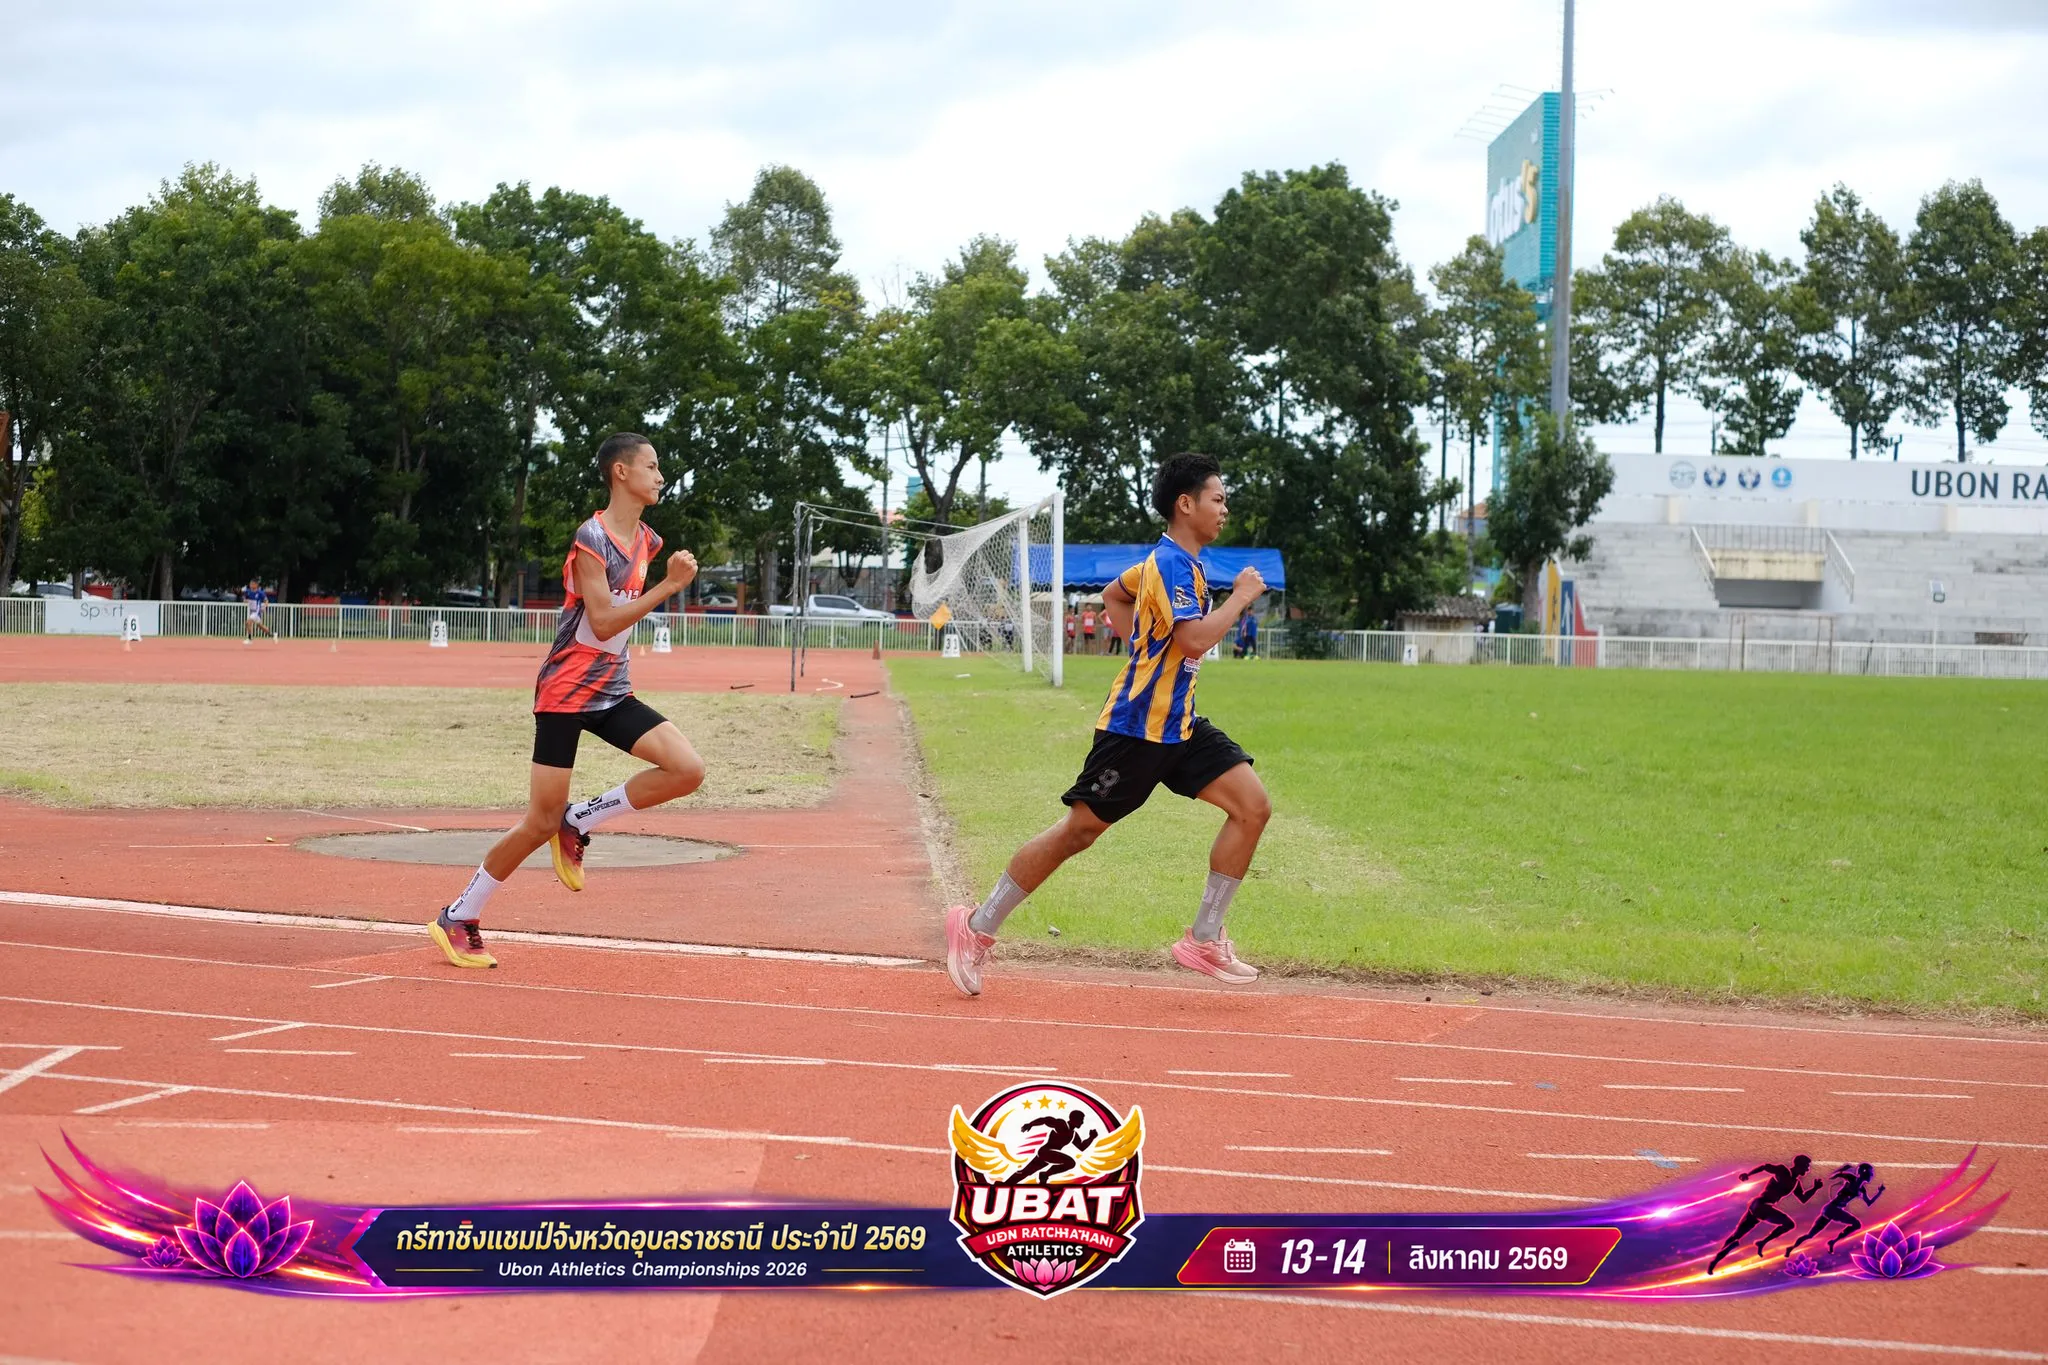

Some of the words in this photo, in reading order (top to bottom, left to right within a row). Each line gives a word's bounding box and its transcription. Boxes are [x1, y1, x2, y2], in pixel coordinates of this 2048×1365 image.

[1911, 469, 1999, 500] UBON
[2012, 472, 2048, 500] RA
[130, 618, 137, 632] 6
[434, 625, 440, 638] 5
[945, 638, 951, 650] 3
